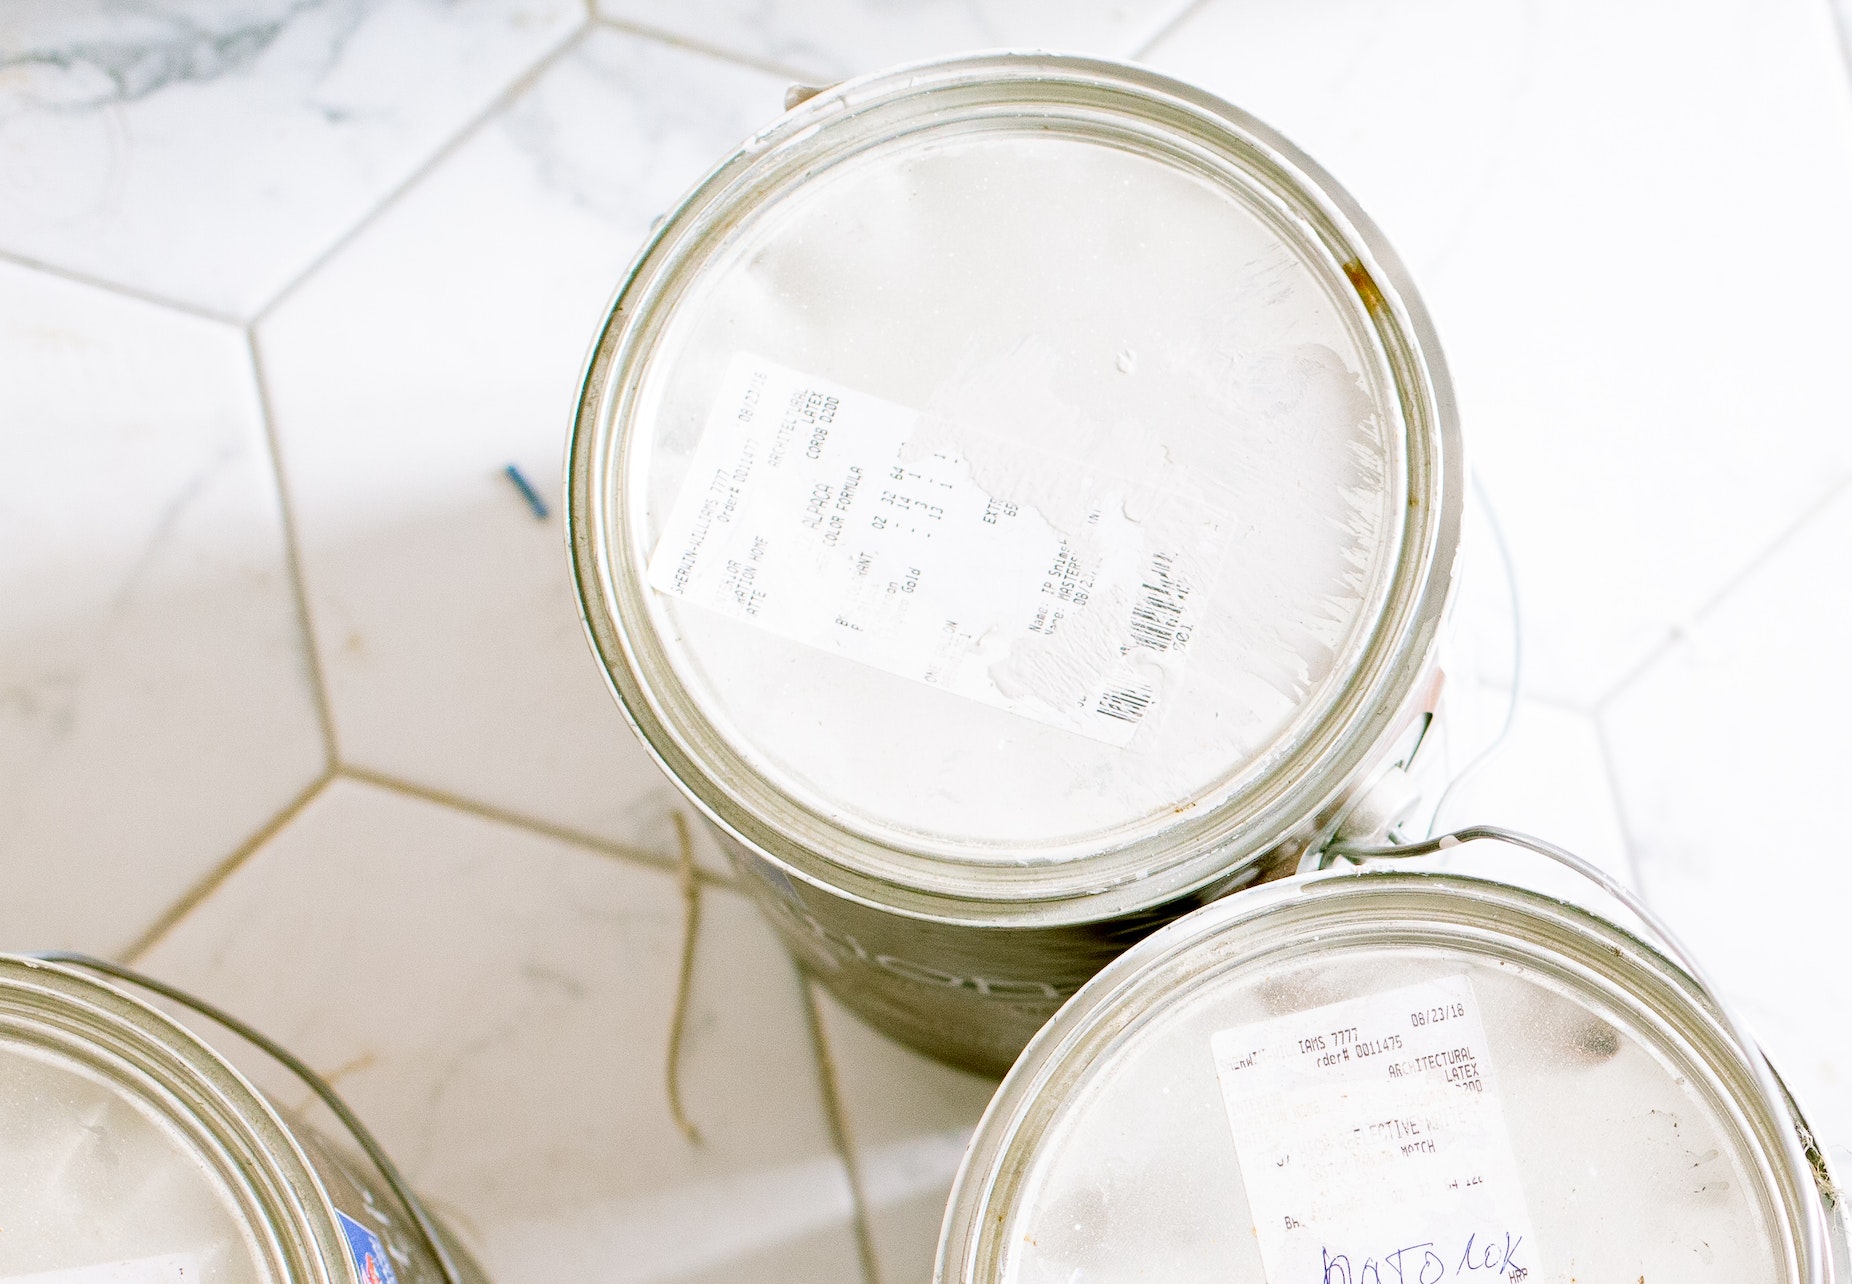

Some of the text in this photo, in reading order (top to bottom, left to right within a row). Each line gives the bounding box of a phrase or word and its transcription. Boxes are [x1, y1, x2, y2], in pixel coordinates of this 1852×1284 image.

[803, 390, 823, 424] LATEX
[805, 427, 828, 459] COROB
[835, 465, 861, 511] FORMULA
[870, 515, 887, 529] OZ
[880, 490, 896, 505] 32
[888, 464, 906, 482] 64
[895, 494, 913, 511] 14
[799, 480, 834, 531] ALPACA
[981, 496, 1004, 526] EXTR
[750, 535, 768, 561] HOME
[900, 567, 921, 593] Gold
[927, 505, 944, 520] 13
[1040, 579, 1057, 596] IP
[744, 588, 767, 618] ATTE
[1410, 1002, 1464, 1027] 08/23/18
[1330, 1026, 1358, 1046] 7777
[1354, 1034, 1403, 1058] 0011475
[1444, 1062, 1479, 1083] LATEX
